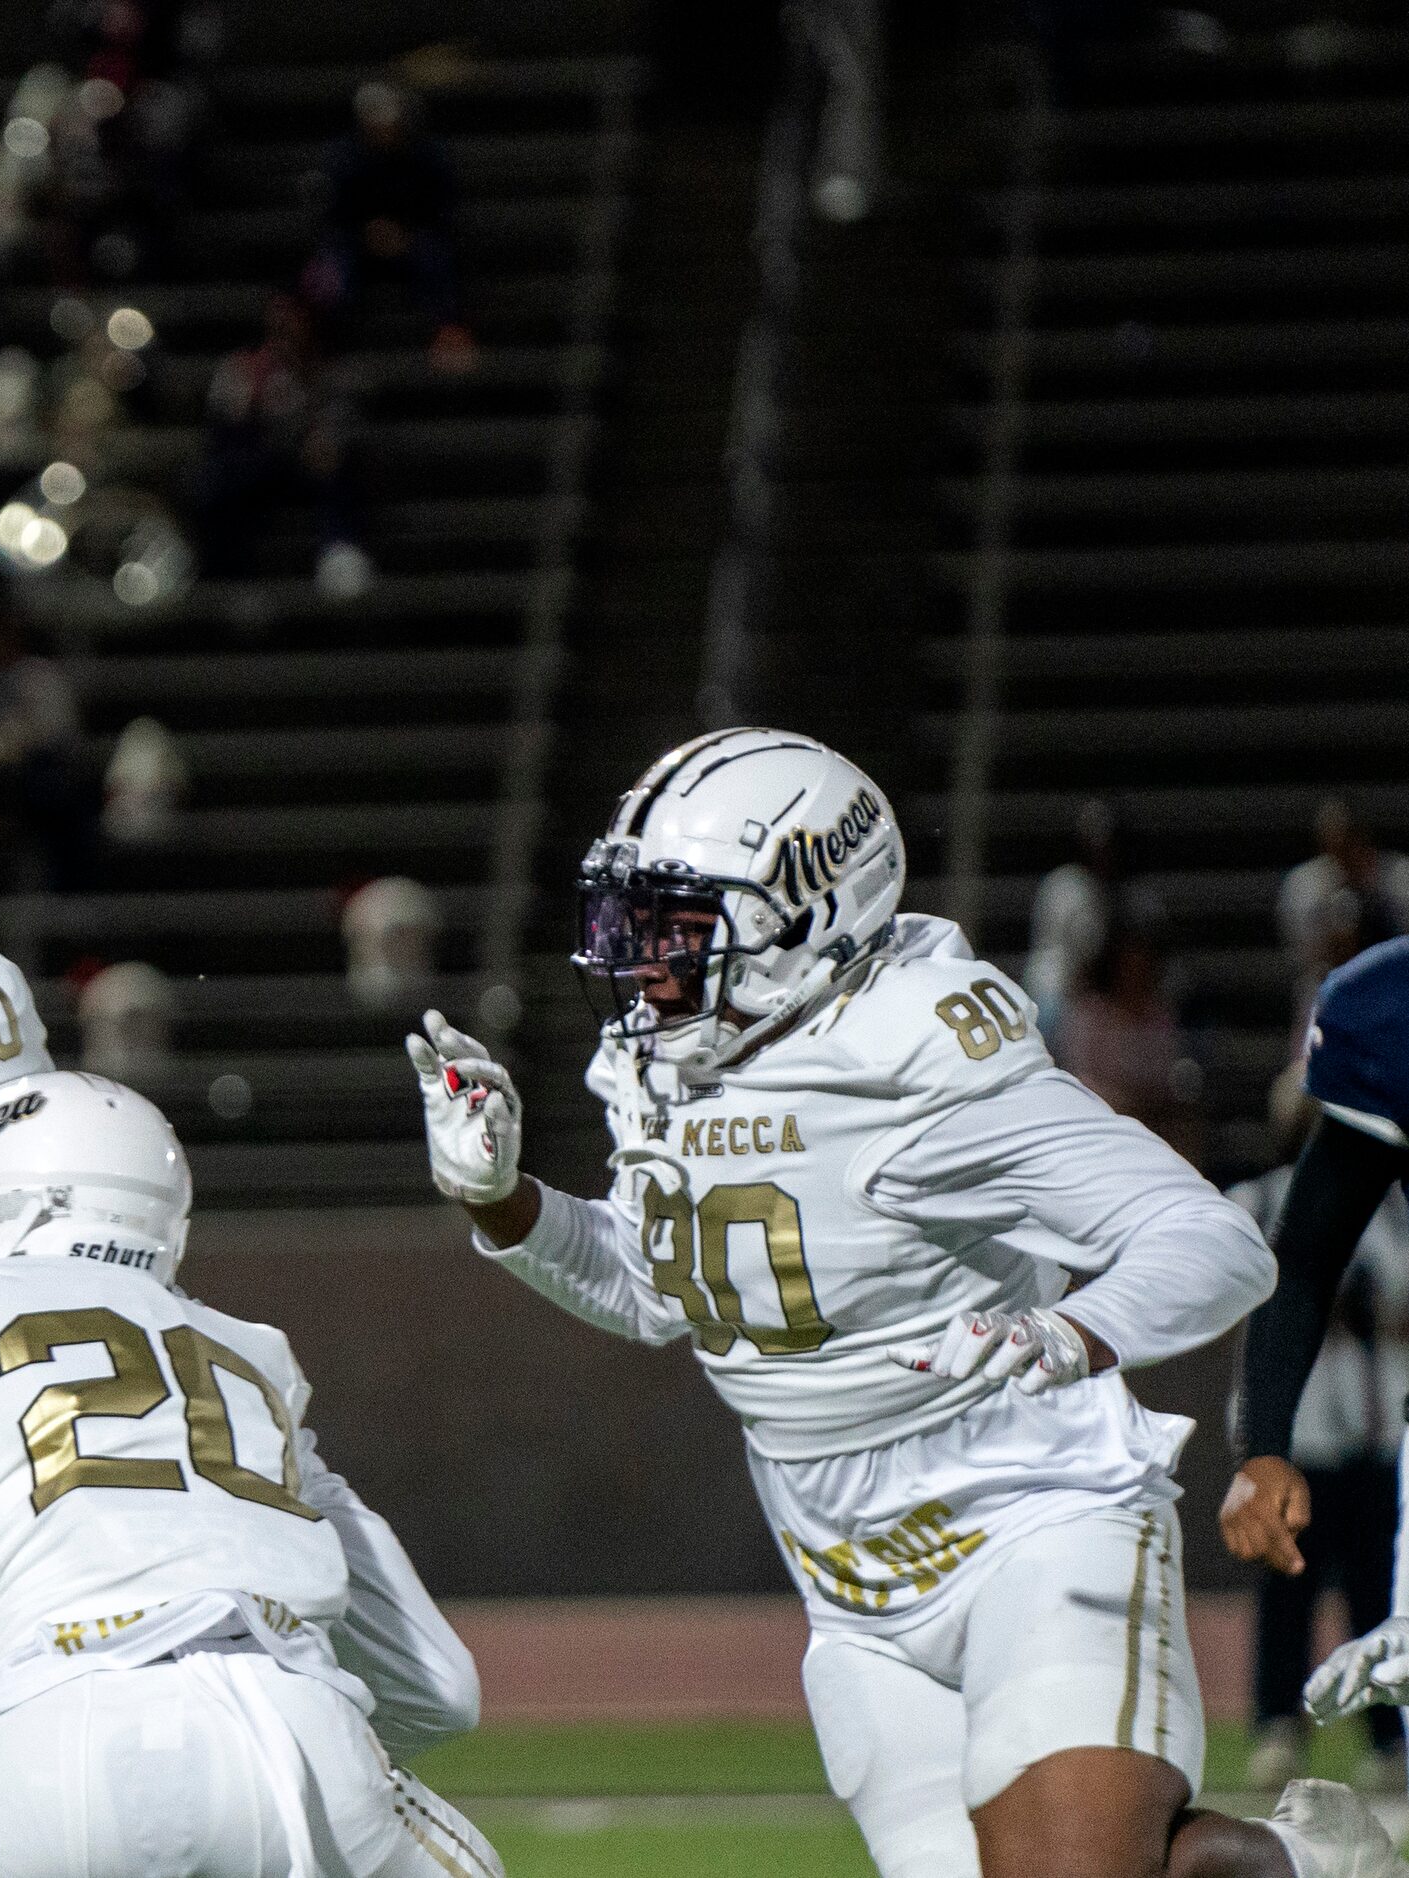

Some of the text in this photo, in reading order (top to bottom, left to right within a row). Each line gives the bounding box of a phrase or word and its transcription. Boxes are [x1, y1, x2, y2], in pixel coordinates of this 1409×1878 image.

[757, 787, 883, 906] Mecca
[935, 977, 1029, 1062] 80
[681, 1114, 806, 1156] MECCA
[69, 1240, 156, 1270] schutt
